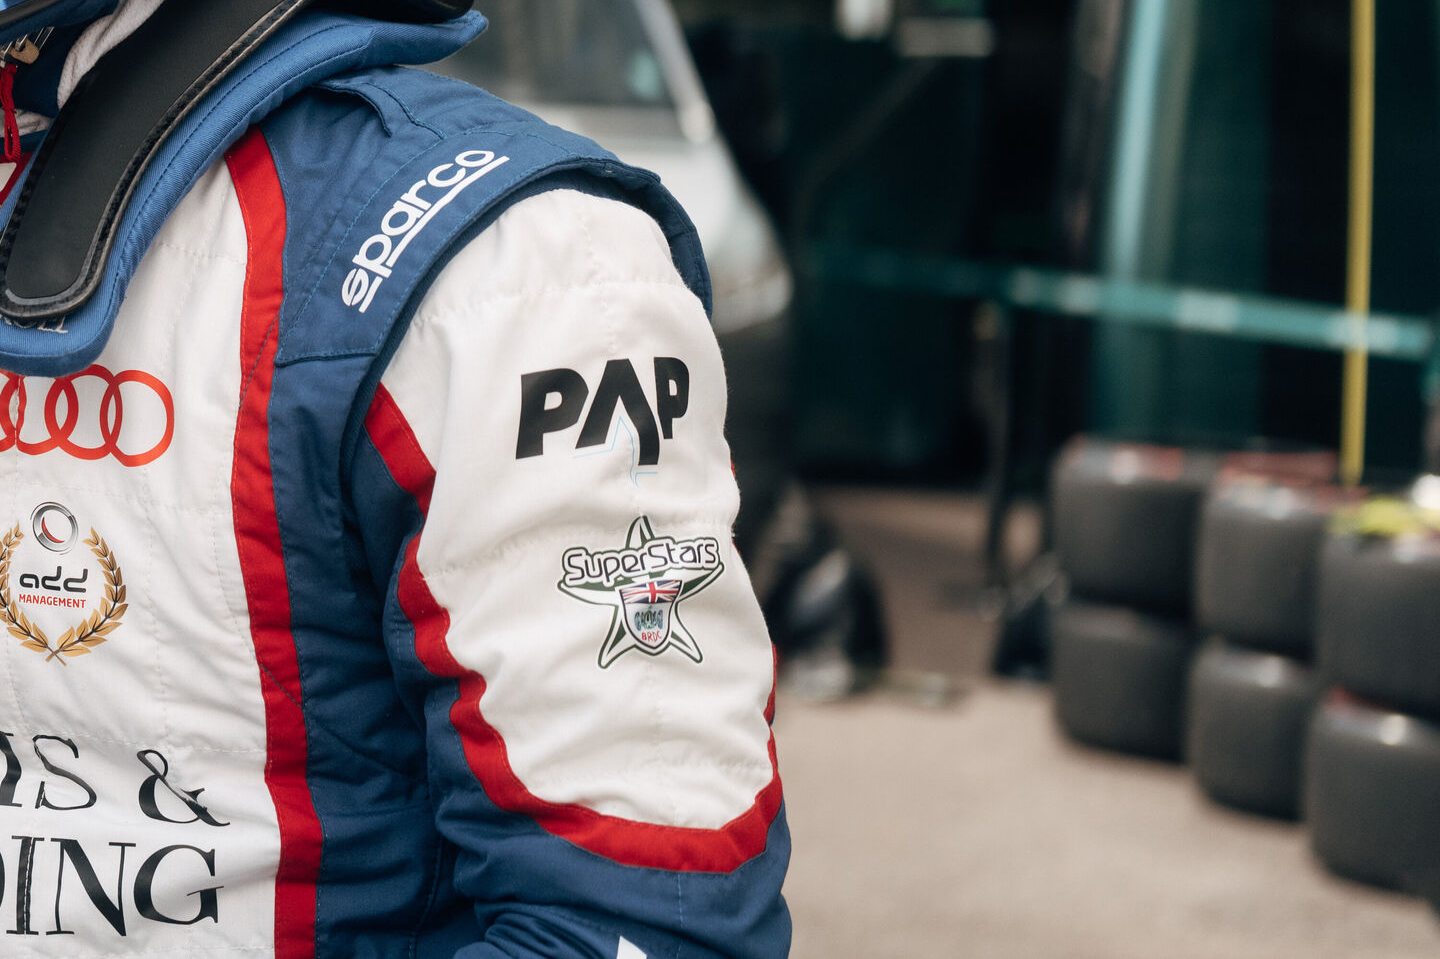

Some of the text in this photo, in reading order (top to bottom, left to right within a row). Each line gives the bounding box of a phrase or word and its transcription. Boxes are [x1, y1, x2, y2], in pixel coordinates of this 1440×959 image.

[341, 150, 510, 314] sparco
[19, 566, 88, 593] add
[19, 594, 86, 608] MANAGEMENT
[641, 631, 662, 642] BRDC
[136, 749, 230, 826] &
